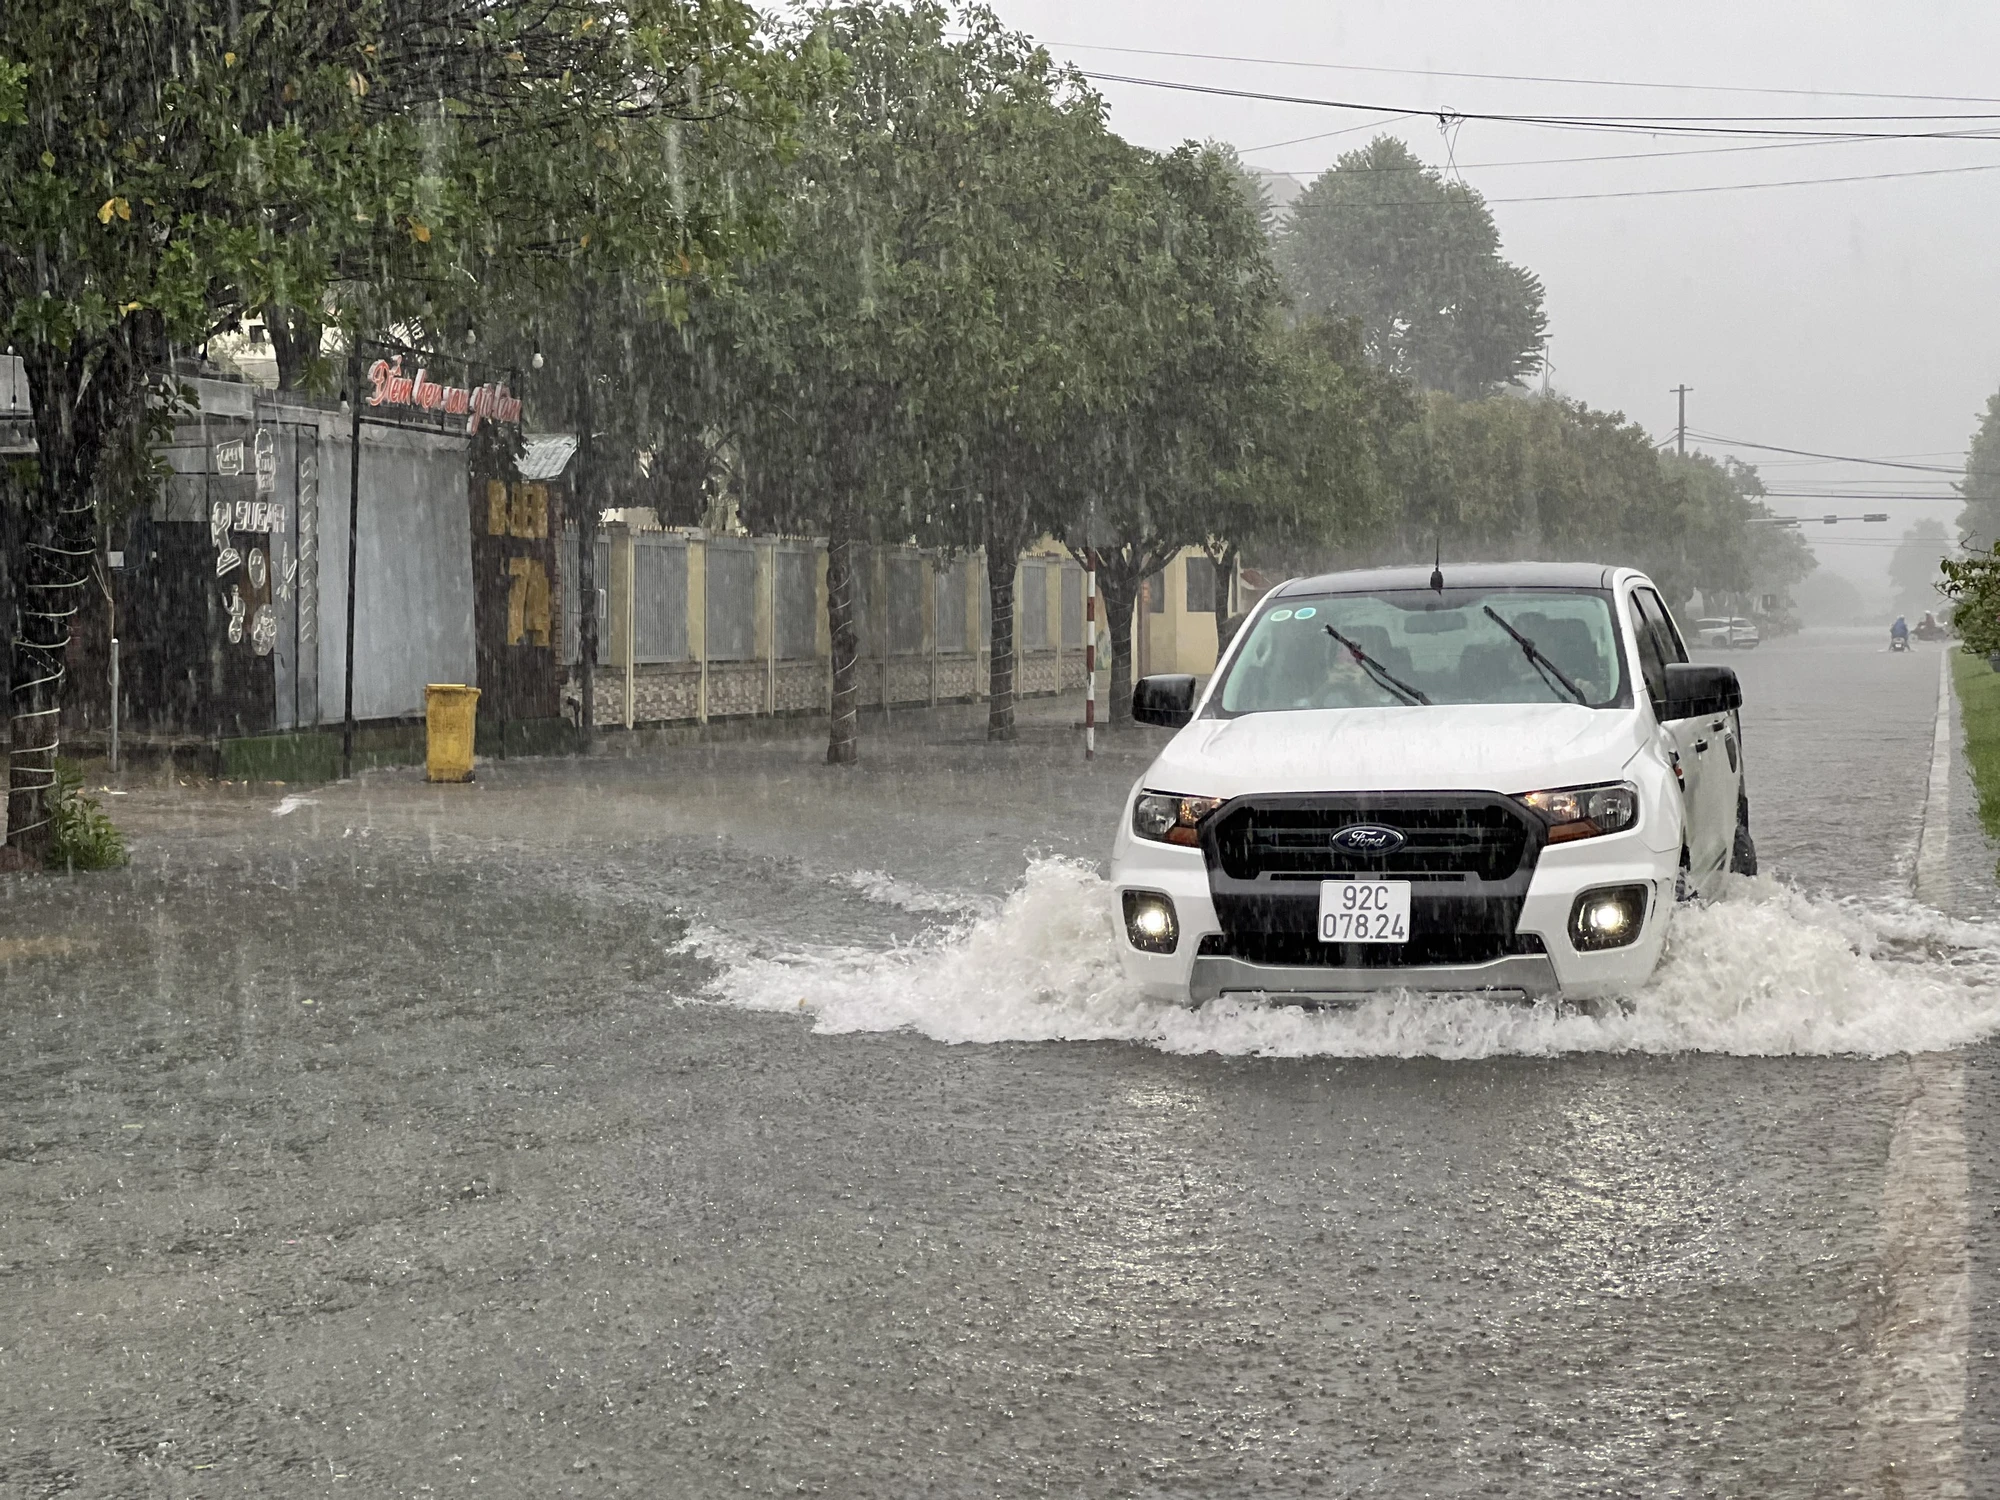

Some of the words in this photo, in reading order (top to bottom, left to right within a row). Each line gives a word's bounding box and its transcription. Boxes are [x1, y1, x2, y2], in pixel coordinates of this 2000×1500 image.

[234, 500, 285, 533] SUGAR
[1347, 830, 1387, 848] Ford
[1342, 885, 1389, 911] 92C
[1322, 913, 1405, 939] 078.24
